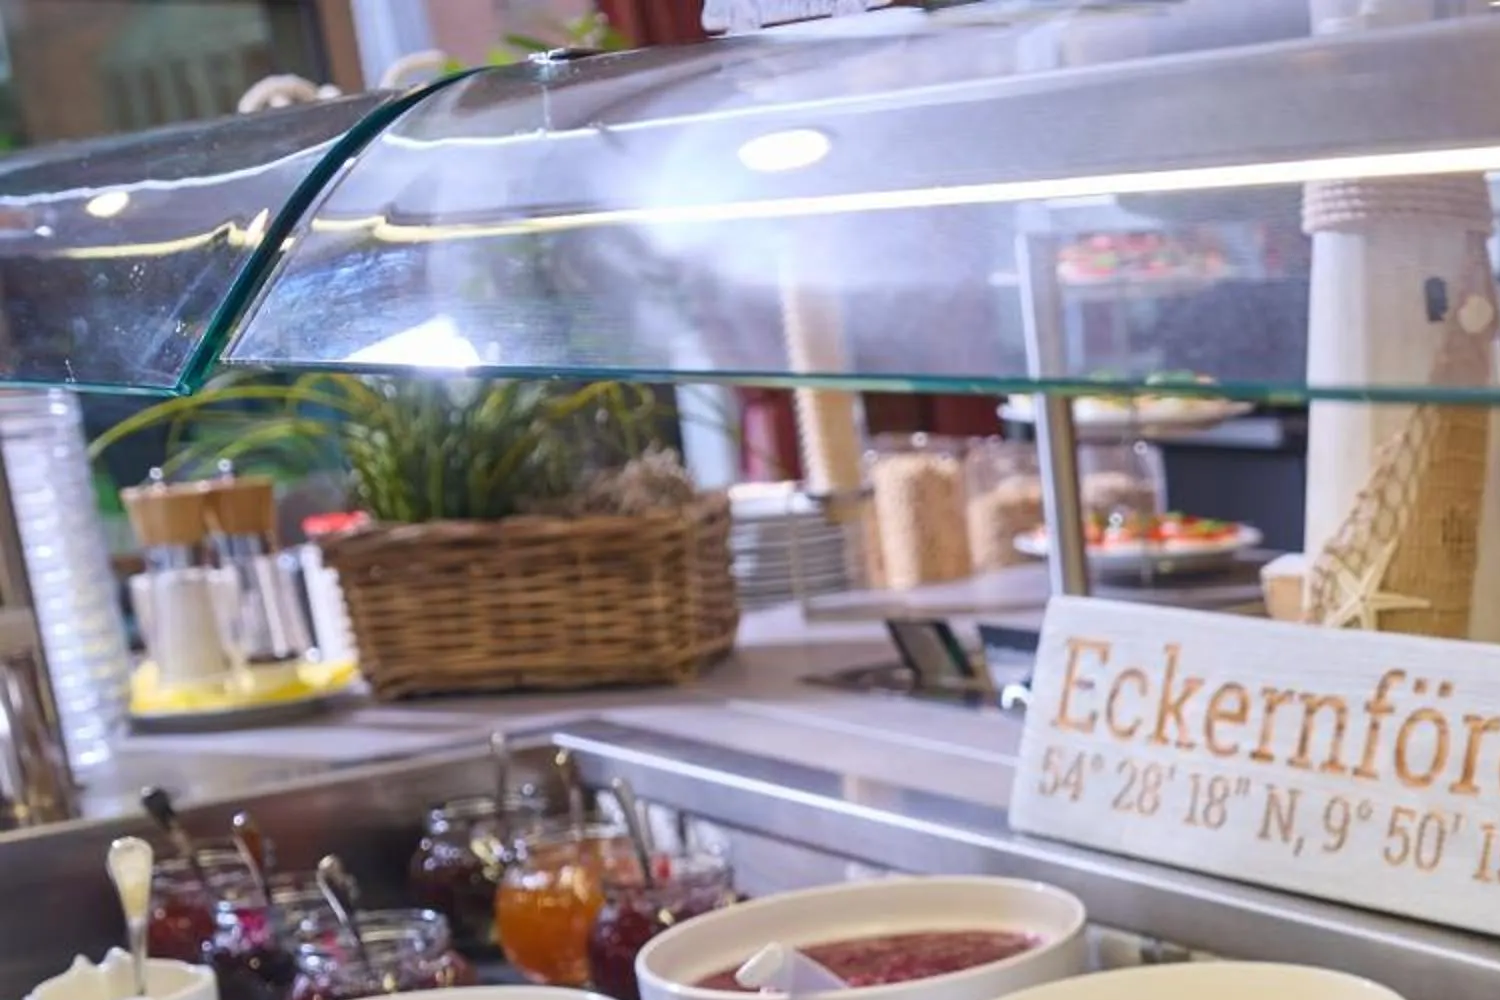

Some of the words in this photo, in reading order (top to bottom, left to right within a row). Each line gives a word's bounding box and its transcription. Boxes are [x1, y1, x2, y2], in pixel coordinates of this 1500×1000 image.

[1037, 746, 1104, 801] 54°
[1111, 758, 1176, 816] 28'
[1257, 783, 1306, 857] N,
[1321, 796, 1374, 853] 9°
[1382, 804, 1464, 872] 50'
